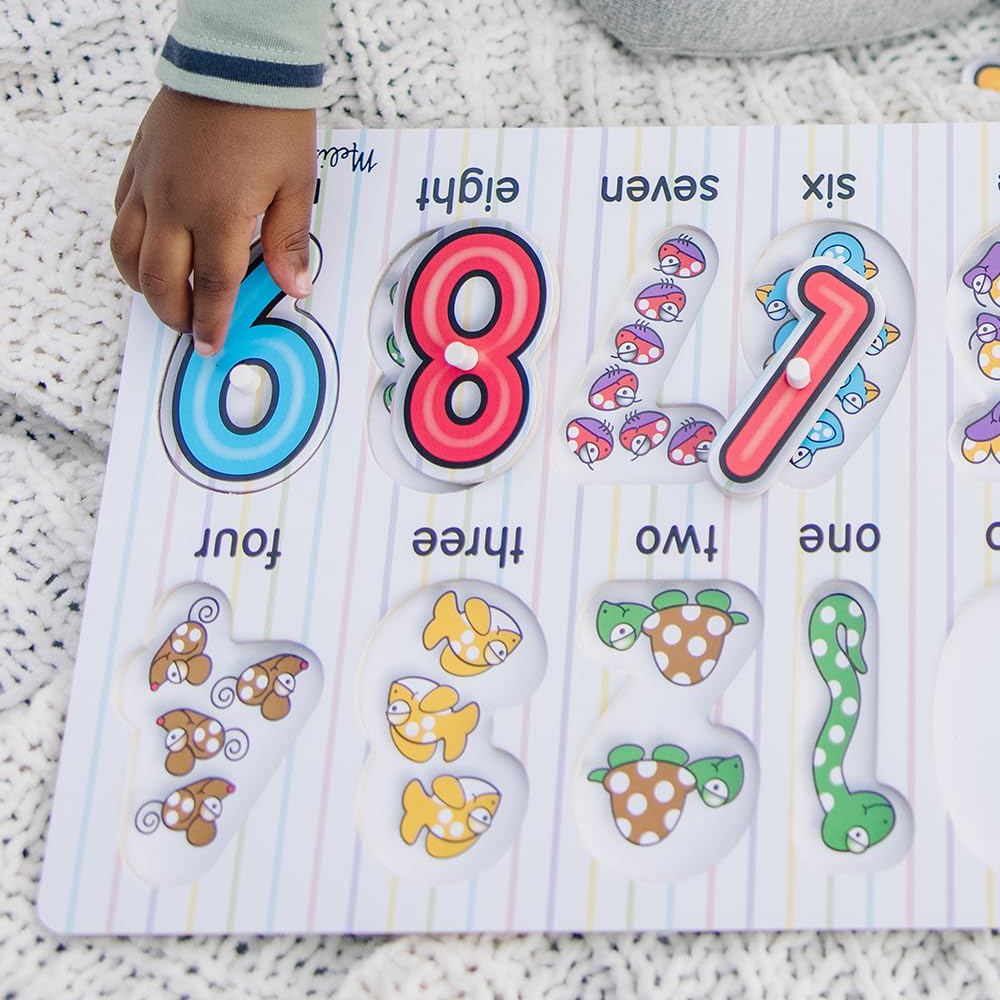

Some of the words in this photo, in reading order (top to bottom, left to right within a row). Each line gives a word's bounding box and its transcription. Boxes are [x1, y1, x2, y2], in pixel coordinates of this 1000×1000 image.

[317, 143, 378, 173] Meli
[416, 168, 518, 214] eight
[602, 176, 718, 202] seven
[803, 174, 855, 208] six
[404, 226, 548, 469] 8
[719, 265, 876, 483] 1
[195, 527, 281, 569] four
[413, 527, 522, 568] three
[637, 526, 716, 561] two
[800, 524, 879, 552] one
